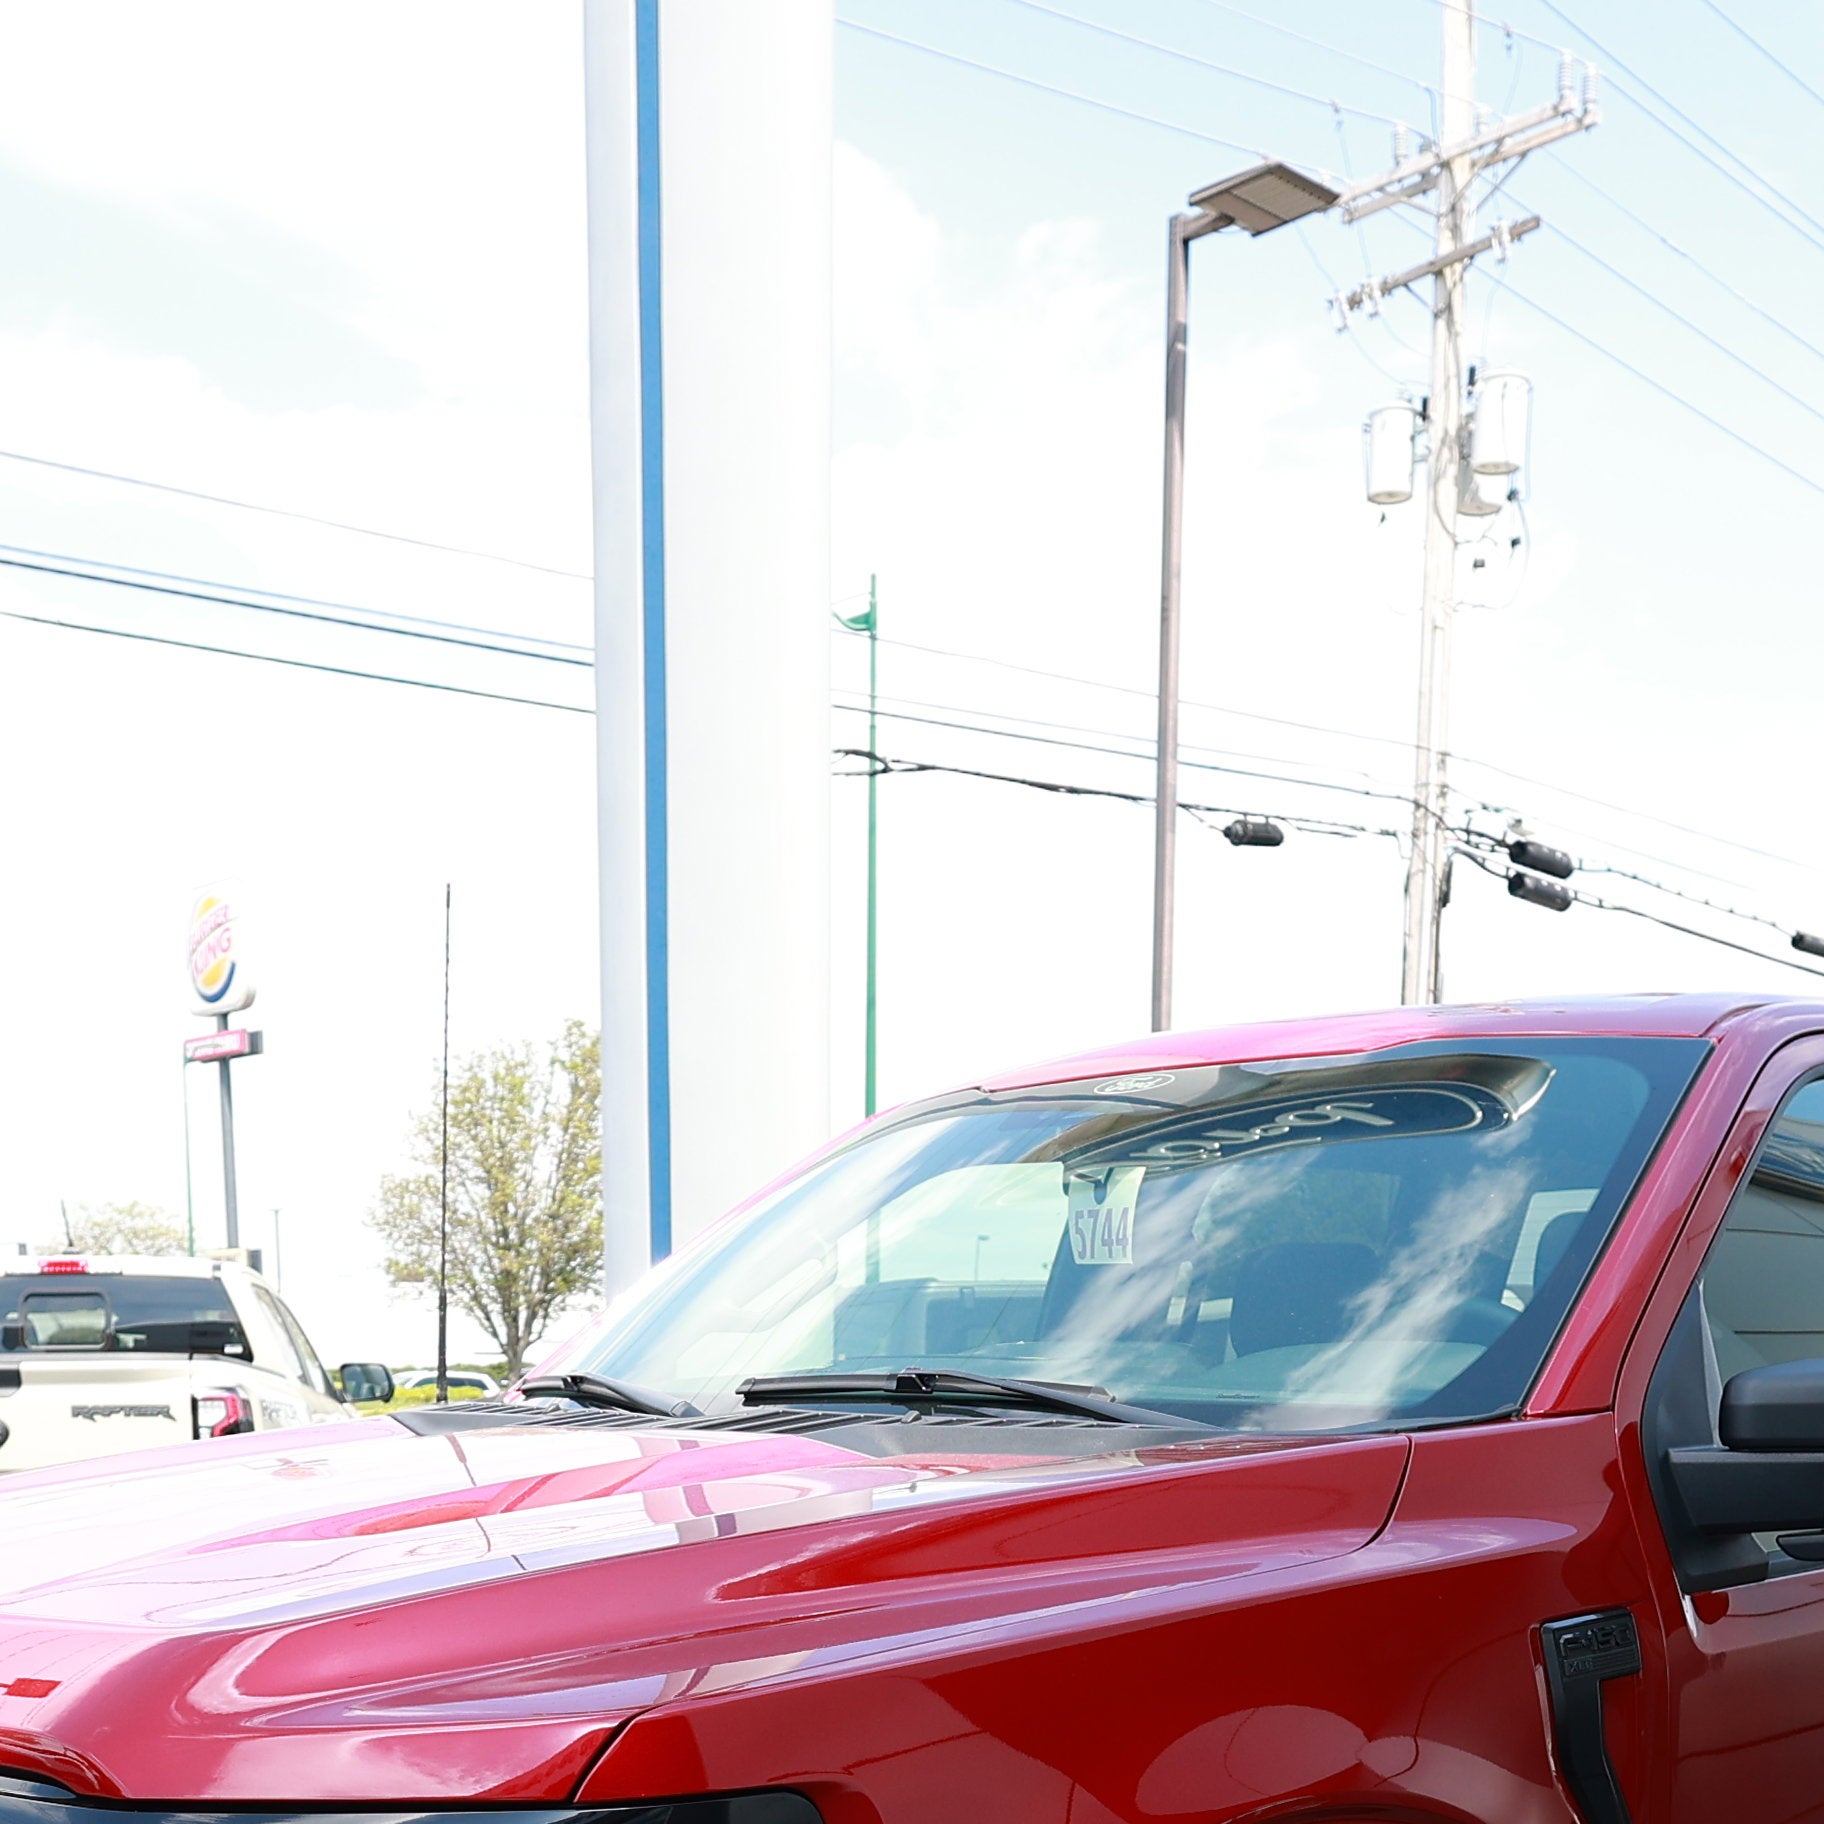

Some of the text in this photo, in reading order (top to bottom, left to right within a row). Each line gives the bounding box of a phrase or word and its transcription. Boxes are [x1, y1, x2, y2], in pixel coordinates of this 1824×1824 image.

[192, 927, 232, 978] KING
[1105, 1075, 1162, 1093] Ford
[1074, 1206, 1129, 1260] 5744
[71, 1404, 177, 1423] RAPTOR
[1559, 1623, 1634, 1657] F-150
